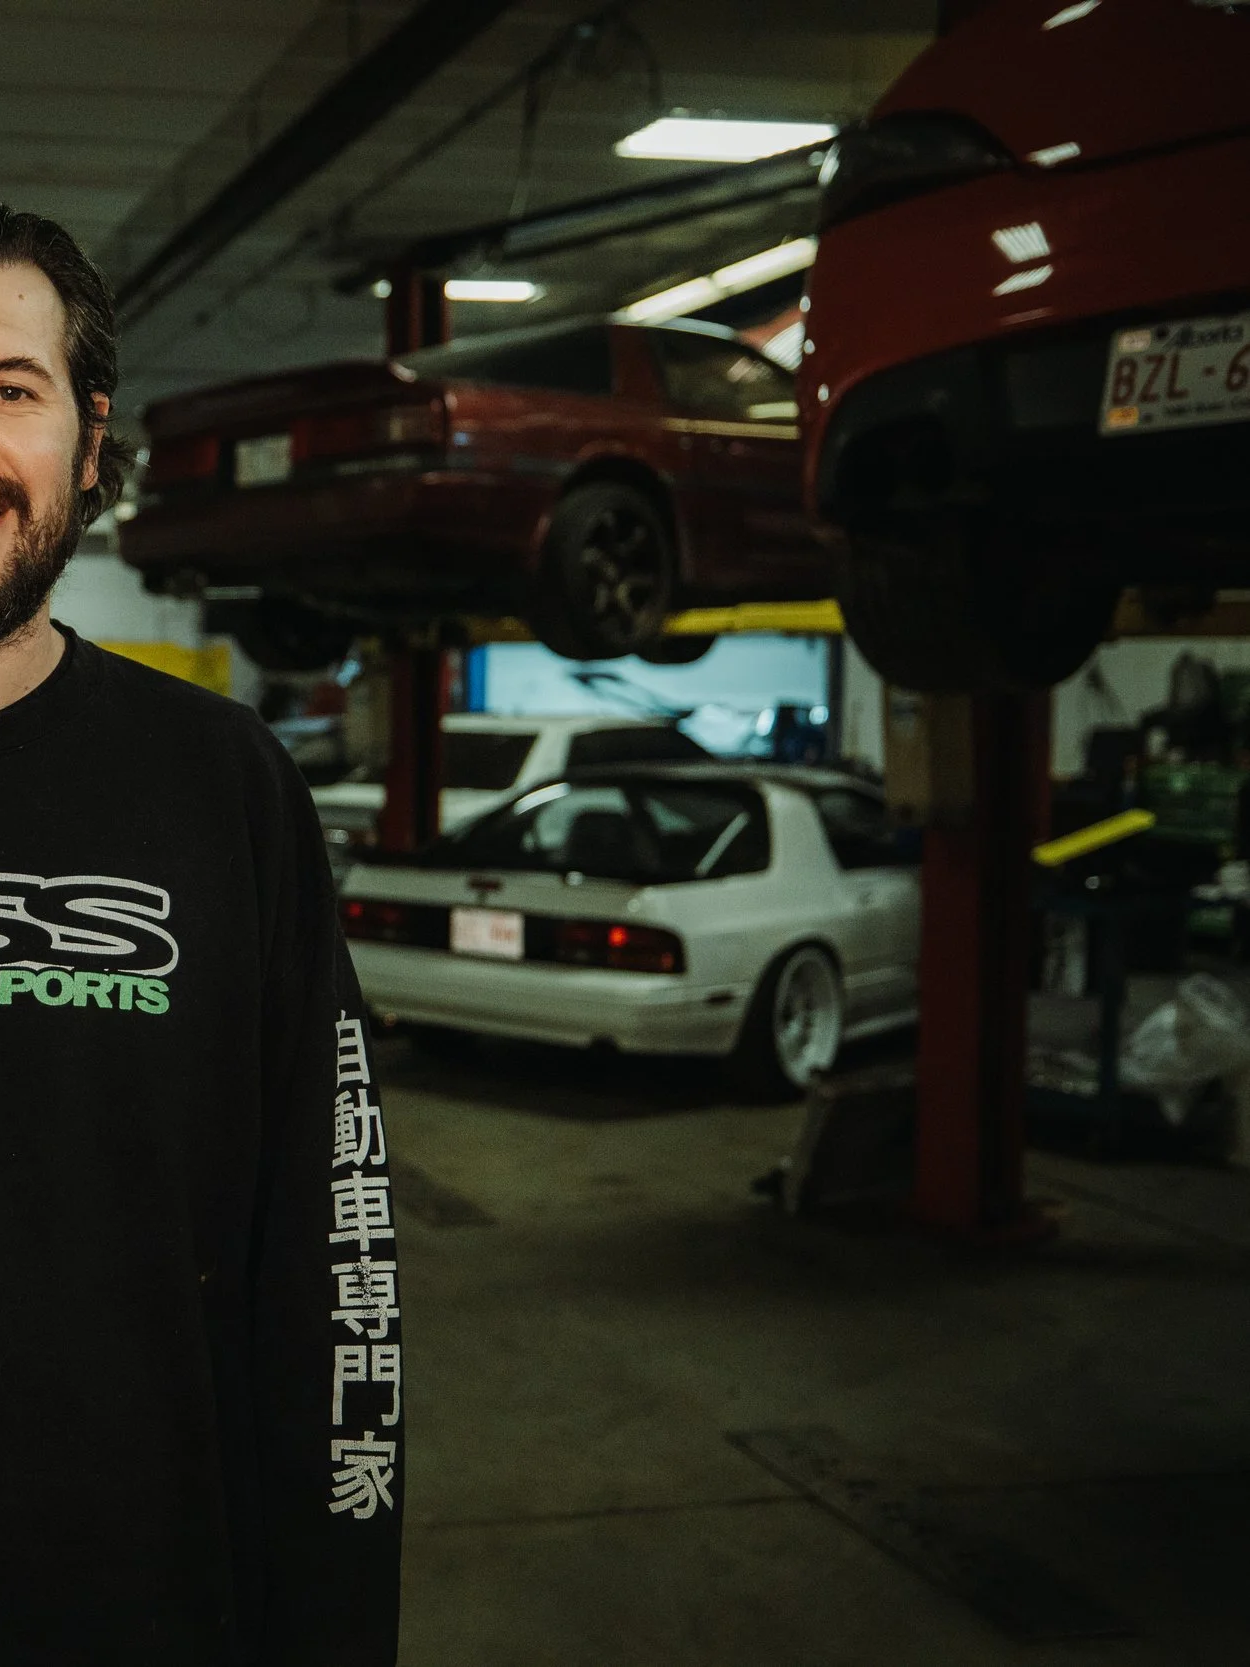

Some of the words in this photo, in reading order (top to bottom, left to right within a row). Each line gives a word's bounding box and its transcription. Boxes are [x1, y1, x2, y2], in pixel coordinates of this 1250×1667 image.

[327, 1009, 401, 1520] 自動車専門家
